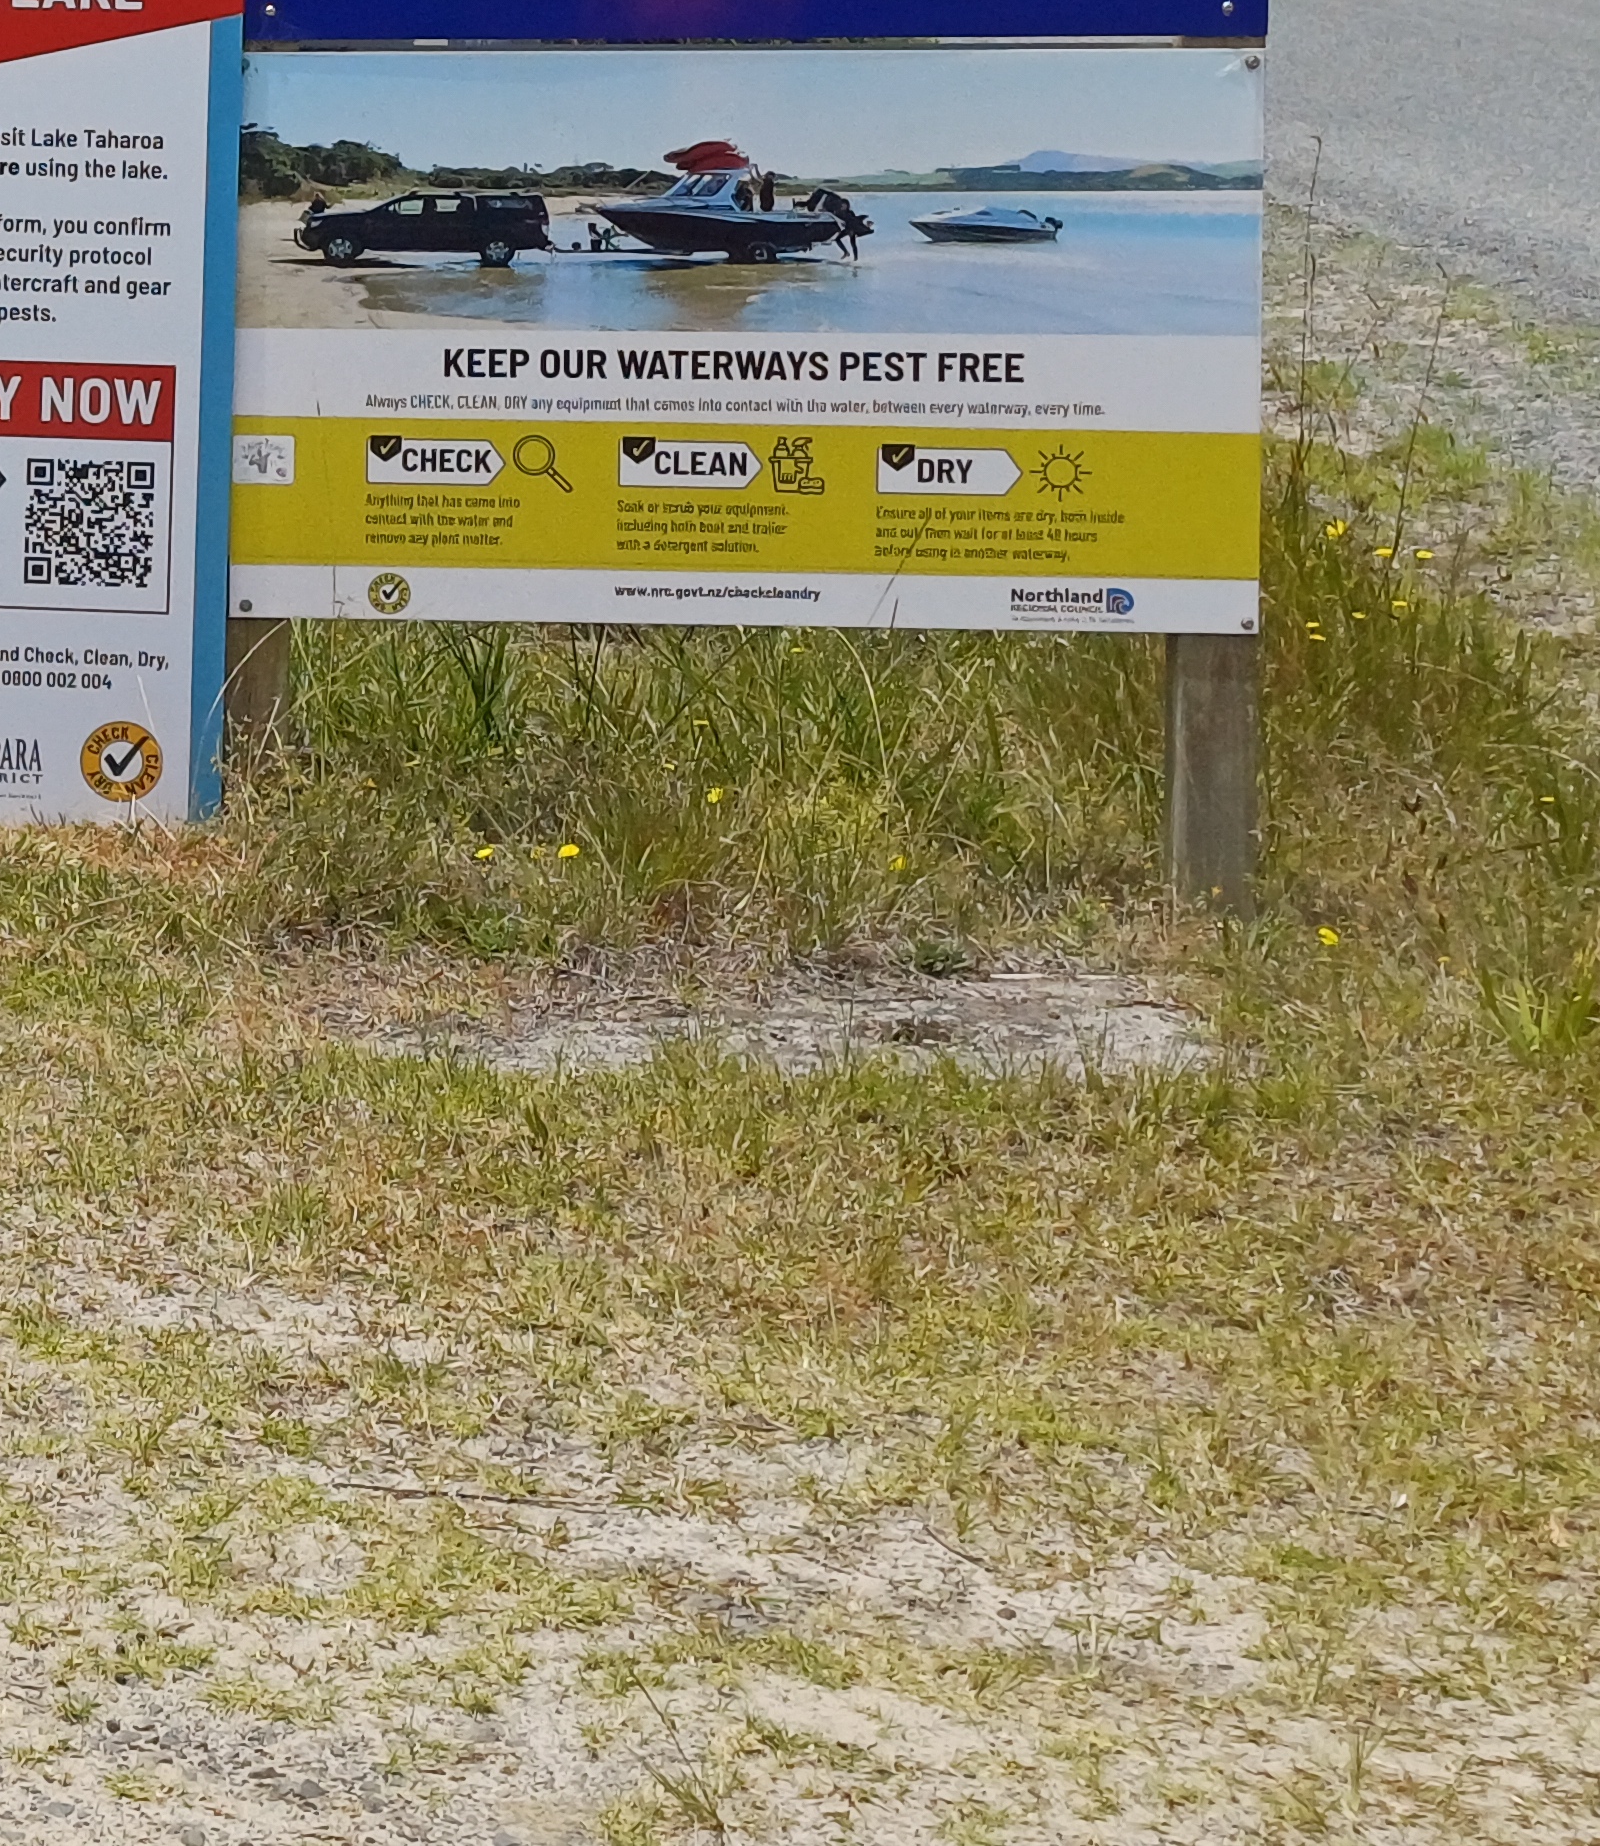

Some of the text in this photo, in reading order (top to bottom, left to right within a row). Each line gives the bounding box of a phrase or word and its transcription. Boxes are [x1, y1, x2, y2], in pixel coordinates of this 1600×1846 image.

[31, 128, 78, 148] Lake
[83, 129, 164, 150] Taharoa
[25, 157, 79, 183] using
[85, 158, 116, 179] the
[122, 160, 168, 180] lake.
[52, 218, 88, 239] you
[93, 216, 171, 237] confirm
[69, 246, 152, 268] protocol
[84, 274, 121, 295] and
[126, 280, 172, 300] gear
[443, 348, 1025, 383] KEEP OUR WATERWAYS PEST FREE
[40, 377, 161, 425] NOW
[401, 448, 492, 474] CHECK
[654, 450, 748, 476] CLEAN
[917, 458, 973, 484] DRY
[1010, 588, 1104, 604] Northland
[24, 646, 79, 666] Check,
[83, 648, 133, 669] Clean,
[138, 650, 169, 672] Dry,
[1, 669, 42, 687] 0800
[46, 671, 77, 689] 002
[81, 673, 112, 690] 004
